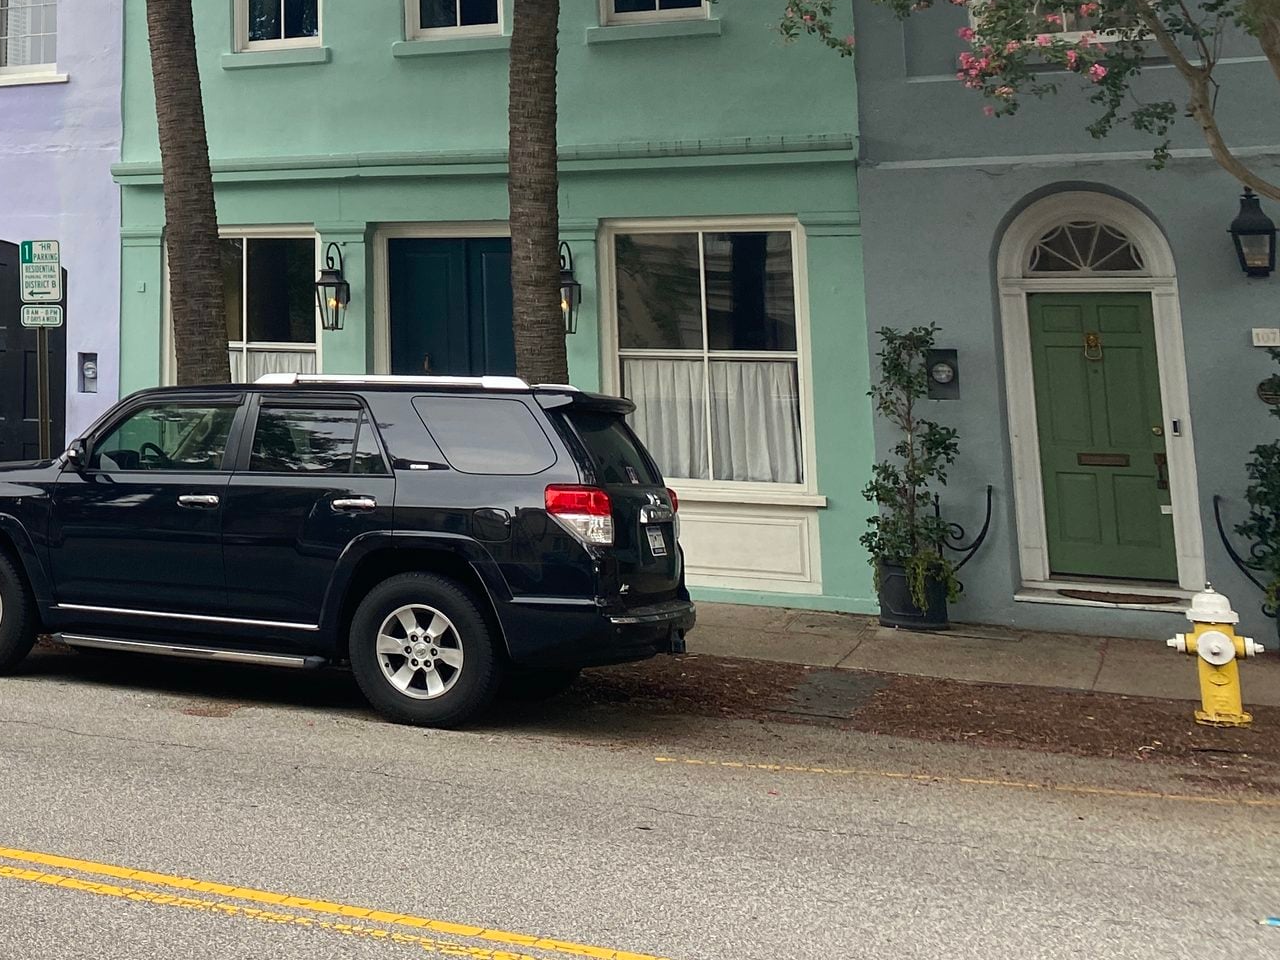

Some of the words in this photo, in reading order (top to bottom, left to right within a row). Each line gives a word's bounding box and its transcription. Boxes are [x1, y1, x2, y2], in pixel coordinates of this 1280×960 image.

[41, 243, 52, 251] HR
[33, 252, 58, 261] PARKING
[25, 265, 56, 273] RESIDENTIAL
[25, 280, 50, 289] DISTRICT
[51, 280, 57, 288] B
